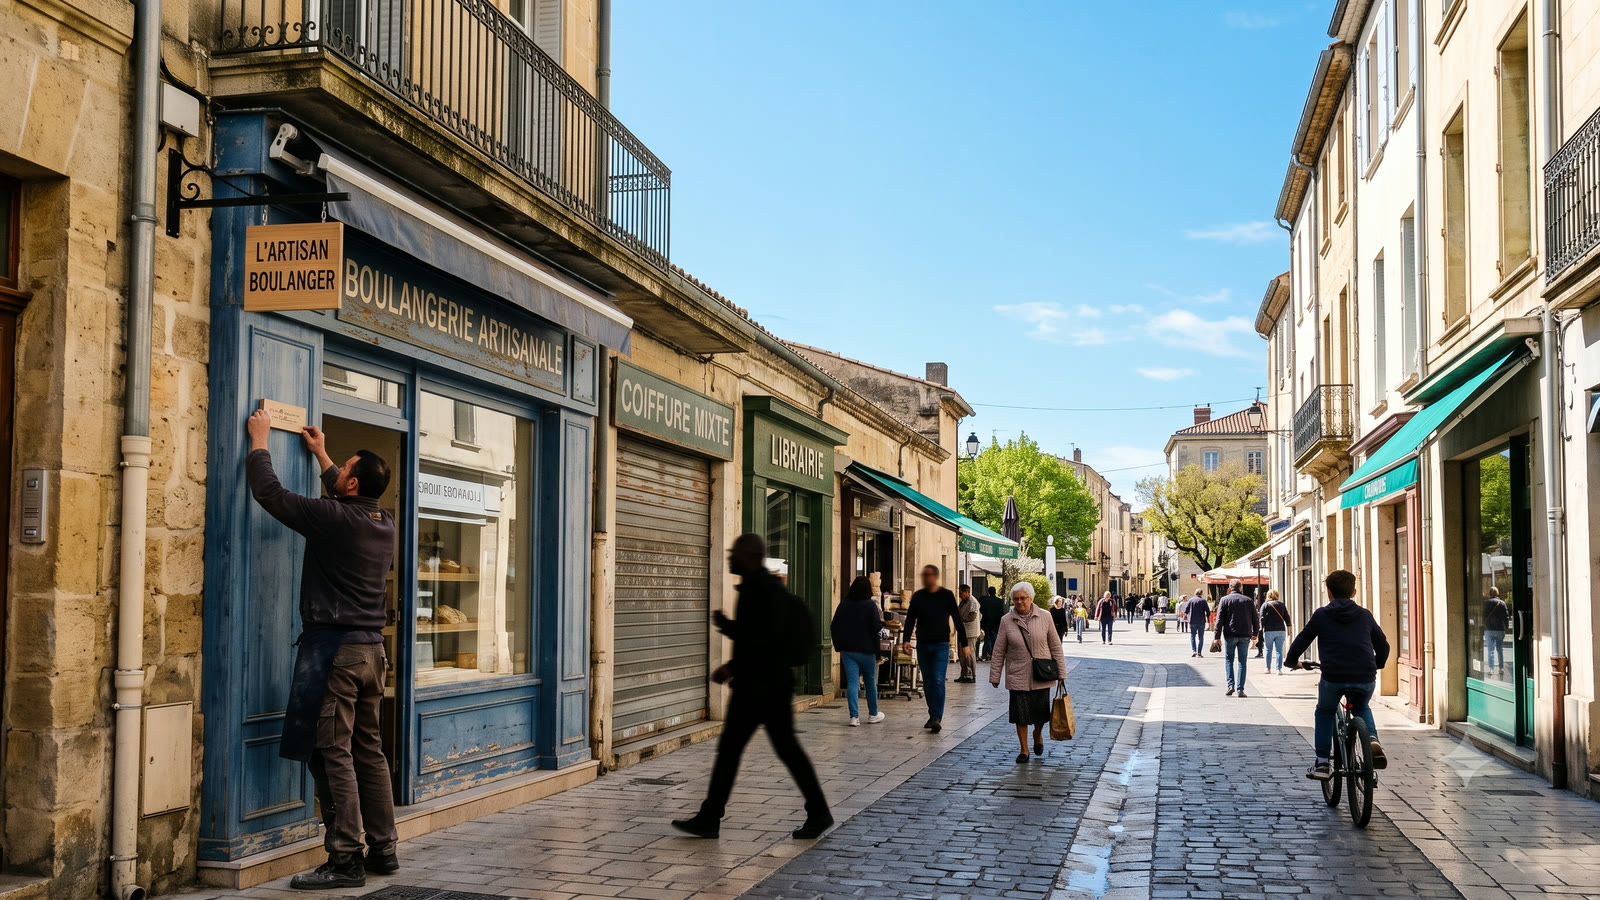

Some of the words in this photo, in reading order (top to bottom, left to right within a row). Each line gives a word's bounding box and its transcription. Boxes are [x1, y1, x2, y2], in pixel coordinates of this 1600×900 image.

[256, 239, 329, 262] L’ARTISAN
[249, 269, 335, 292] BOULANGER
[345, 258, 474, 343] BOULANGERIE
[478, 315, 563, 376] ARTISANALE
[621, 378, 691, 434] COIFFURE
[694, 406, 729, 447] MIXTE
[771, 433, 824, 480] LIBRAIRIE
